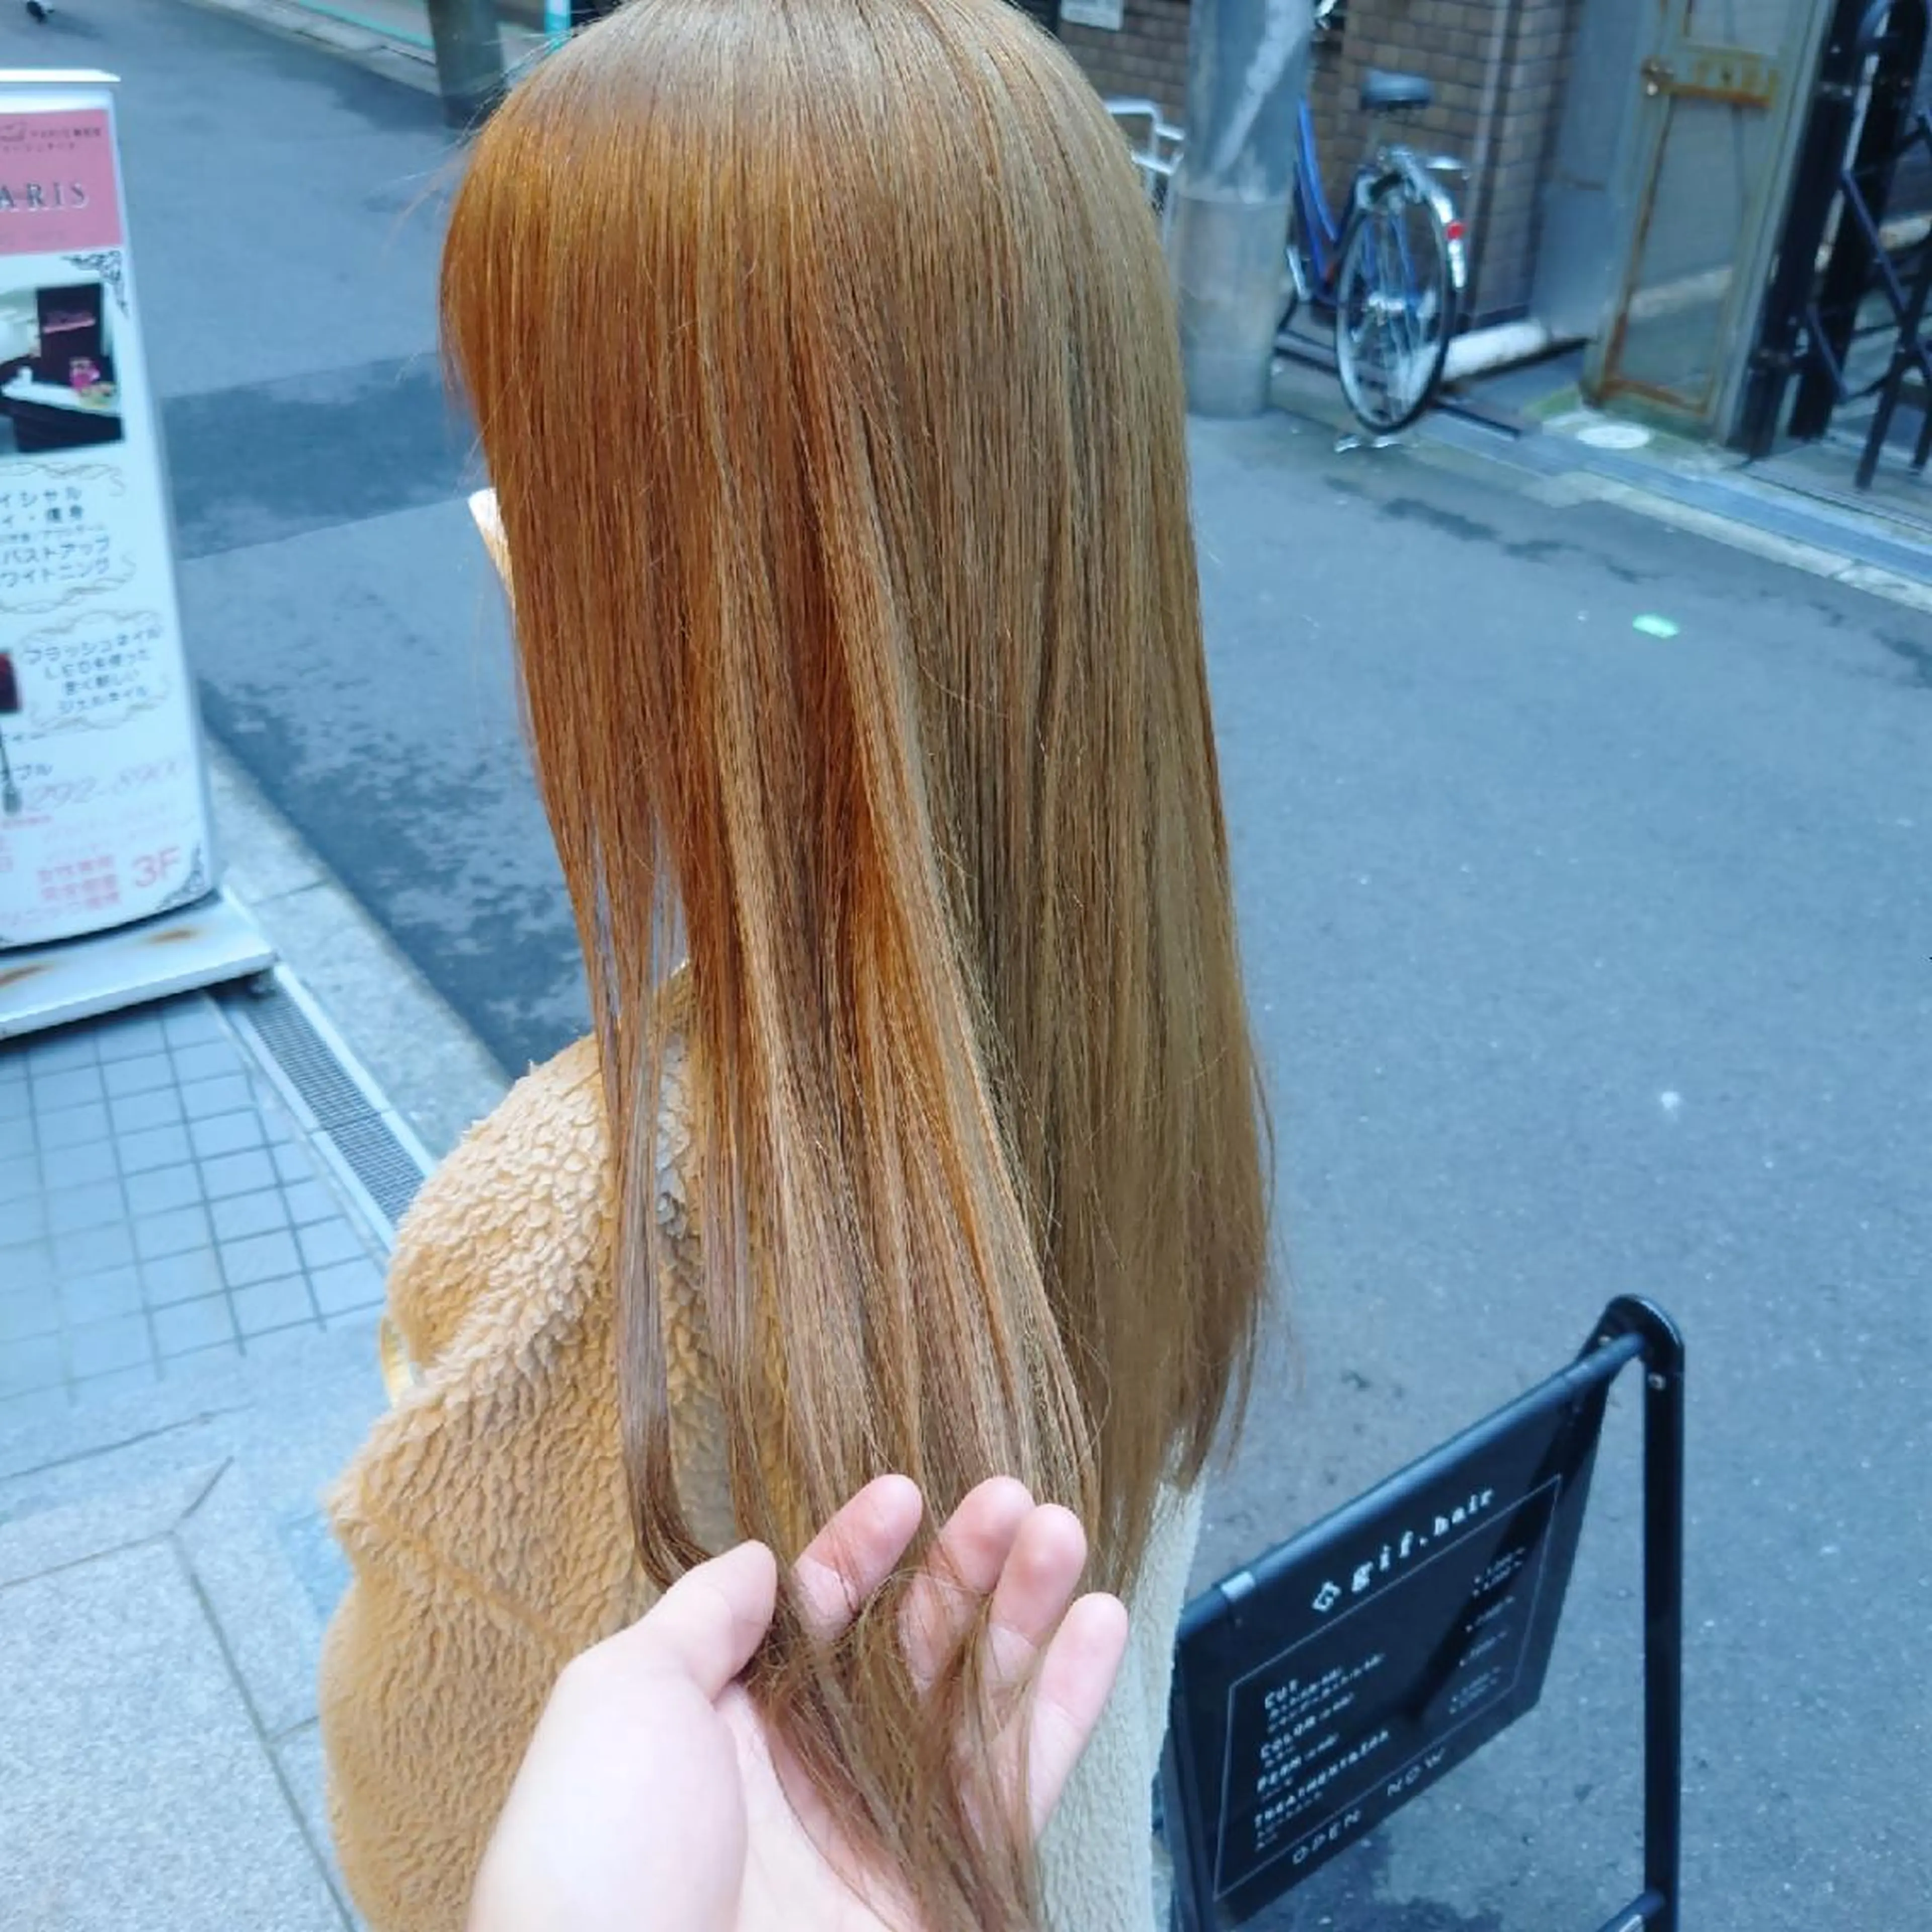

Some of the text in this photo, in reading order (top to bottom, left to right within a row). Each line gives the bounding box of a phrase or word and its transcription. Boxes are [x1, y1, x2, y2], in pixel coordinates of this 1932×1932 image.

[132, 846, 181, 888] 3F
[1293, 1810, 1361, 1865] OPEN
[1386, 1747, 1445, 1797] NOW
